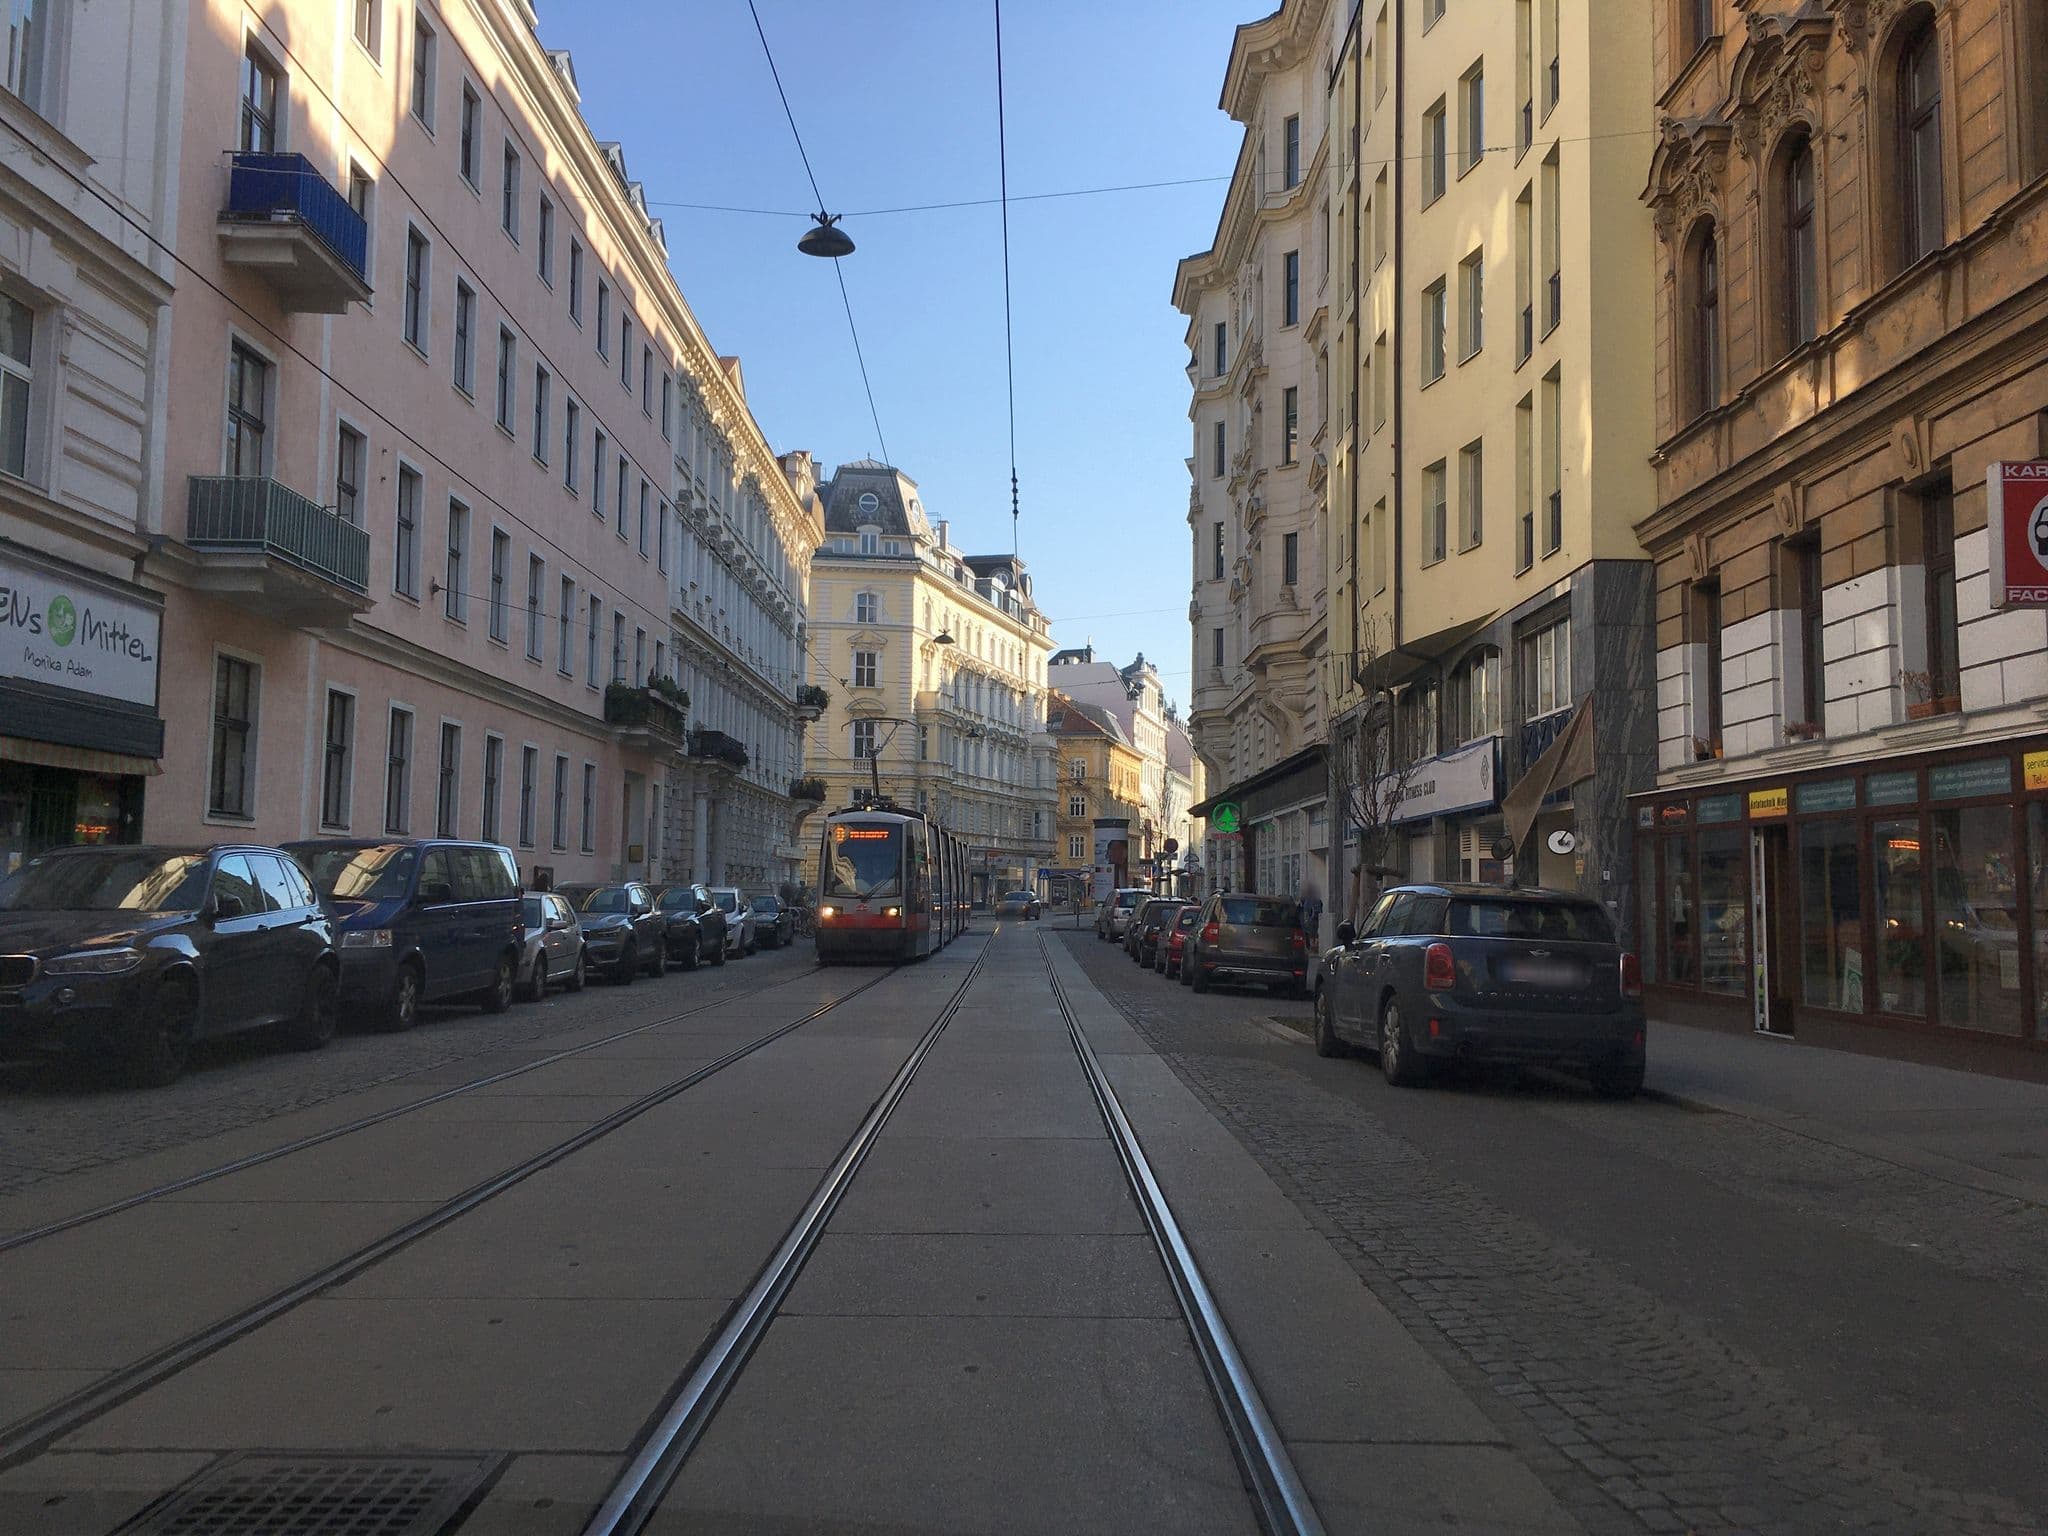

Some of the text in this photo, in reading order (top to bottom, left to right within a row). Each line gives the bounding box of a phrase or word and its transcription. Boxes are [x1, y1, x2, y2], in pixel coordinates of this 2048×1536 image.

[2008, 589, 2048, 601] FAC
[24, 646, 93, 678] Monika Adam
